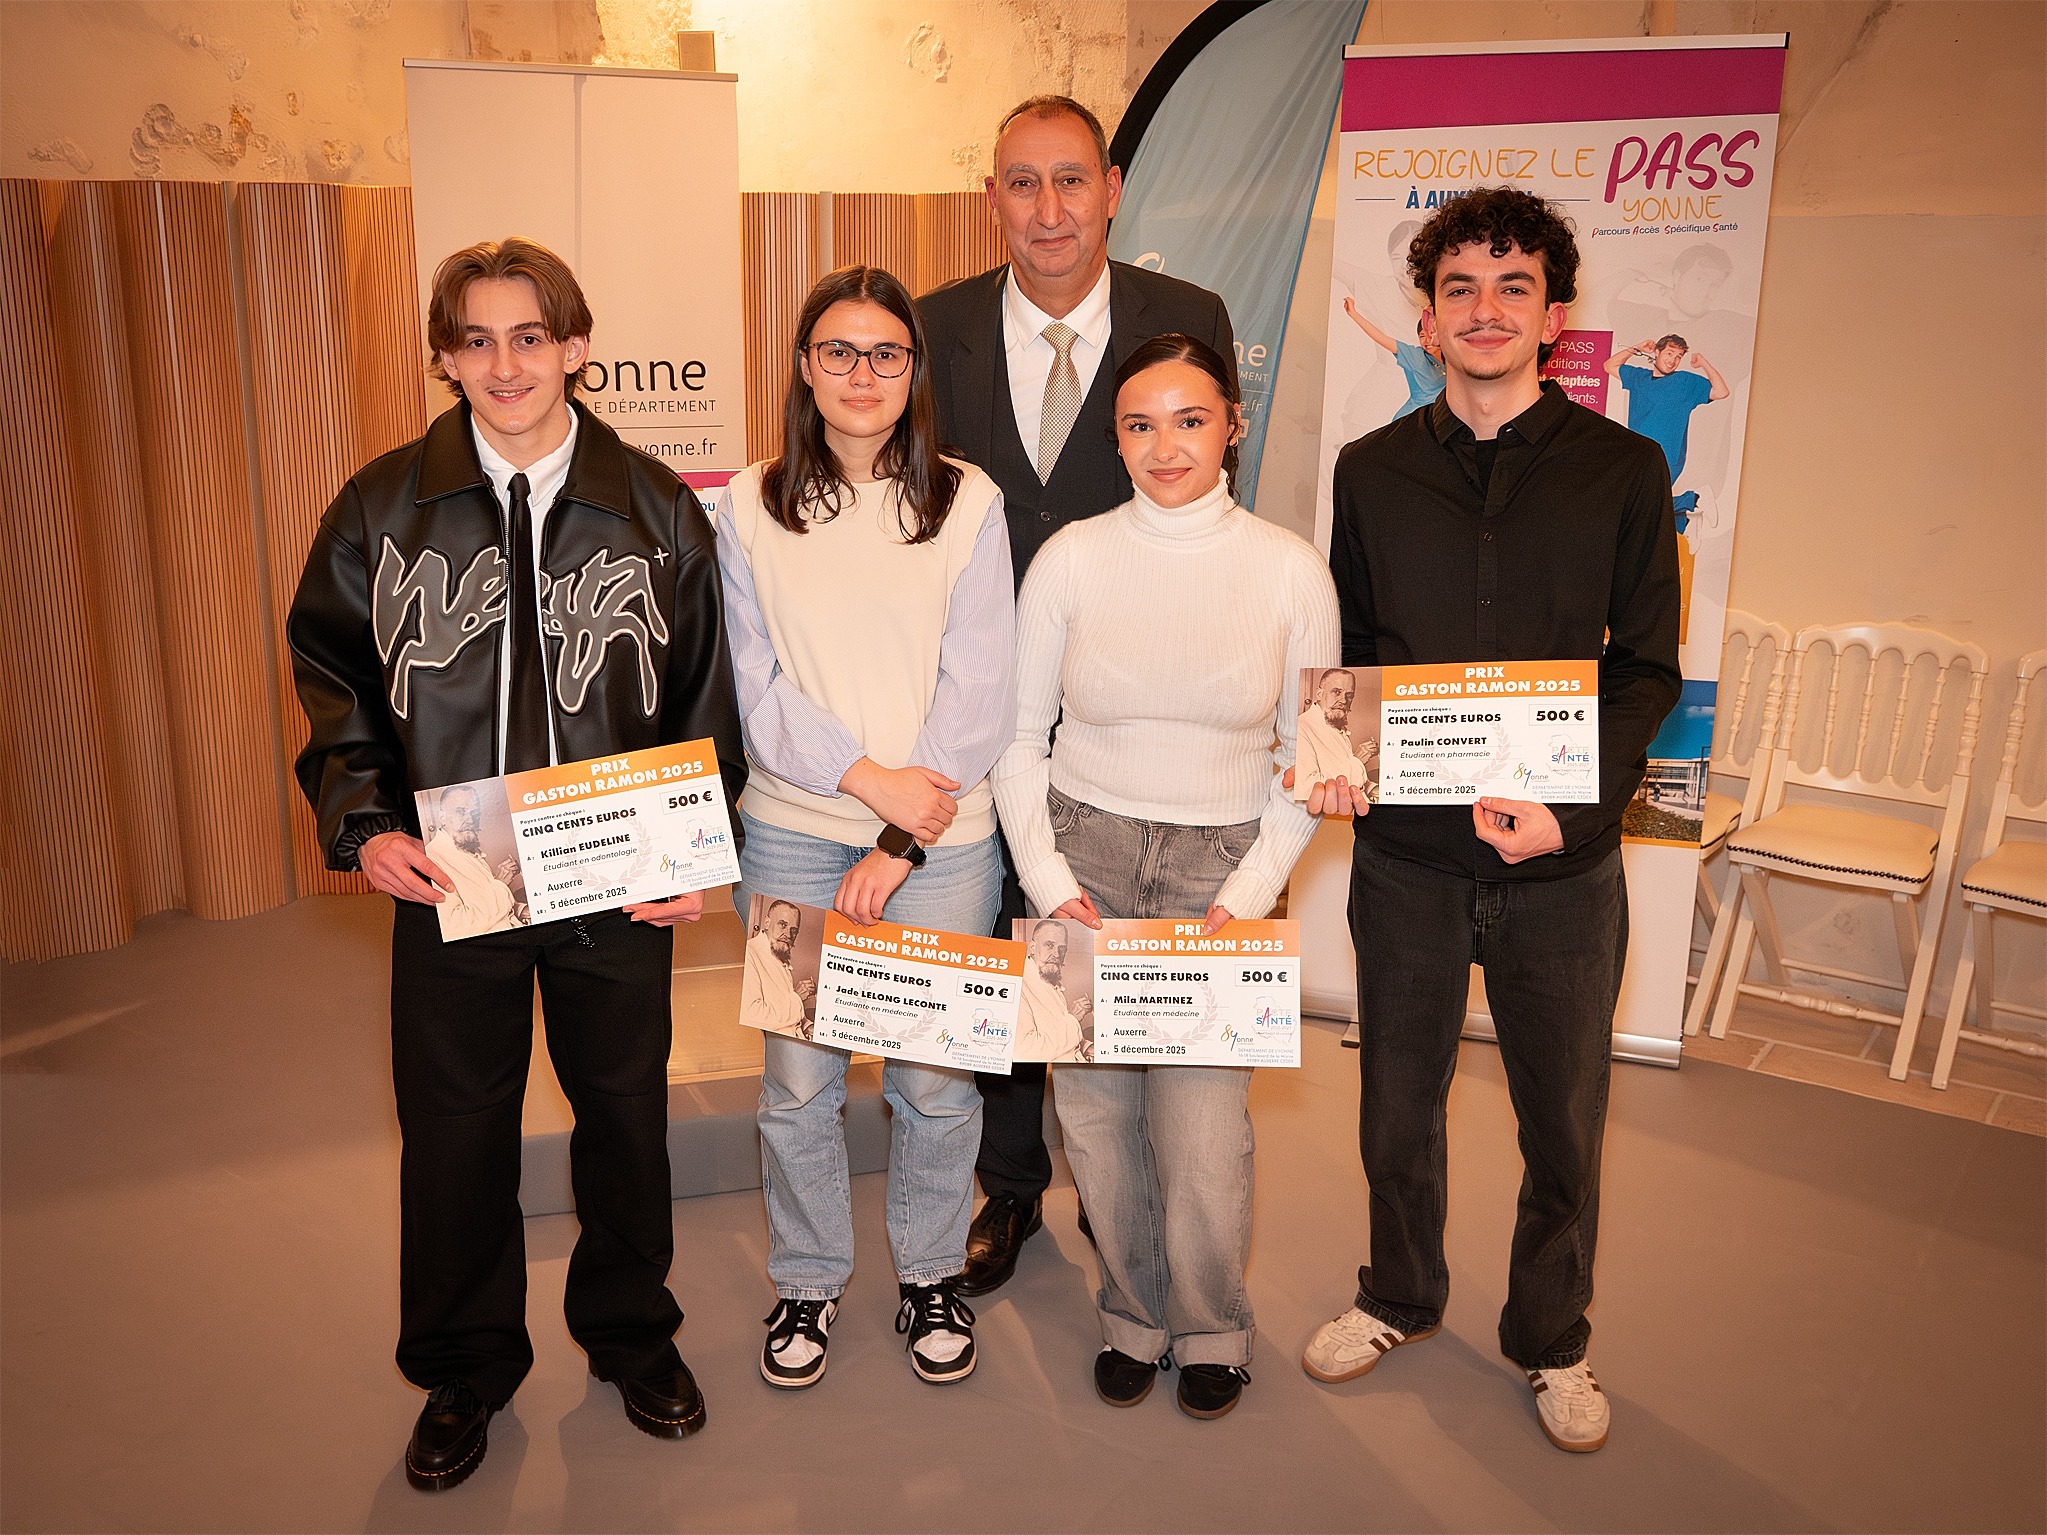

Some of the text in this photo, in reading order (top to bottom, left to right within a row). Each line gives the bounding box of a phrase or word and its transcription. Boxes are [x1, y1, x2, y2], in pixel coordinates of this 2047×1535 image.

[1354, 129, 1760, 203] REJOIGNEZ LE PASS
[1405, 185, 1420, 209] À
[1622, 195, 1722, 222] YONNE
[1591, 222, 1739, 238] Parcours Accès Spécifique Santé
[1560, 341, 1595, 354] PASS
[1548, 358, 1591, 370] ditions
[582, 360, 707, 392] onne
[1550, 374, 1600, 388] daptées
[608, 398, 717, 414] DÉPARTEMENT
[1465, 666, 1505, 679] PRIX
[1395, 679, 1581, 697] GASTON RAMON 2025
[1388, 713, 1502, 725] CINQ CENTS EUROS
[1536, 710, 1585, 722] 500 €
[1400, 738, 1434, 747] Paulin
[1436, 737, 1487, 746] CONVERT
[1400, 751, 1434, 759] Étudiant
[1446, 750, 1491, 759] pharmacie
[590, 757, 631, 777] PRIX
[1399, 770, 1435, 778] Auxerre
[522, 760, 704, 806] GASTON RAMON 2025
[1399, 786, 1405, 794] 5
[1407, 785, 1452, 795] décembre
[1454, 785, 1476, 794] 2025
[668, 790, 713, 809] 500 €
[522, 807, 637, 838] CINQ CENTS EUROS
[540, 846, 577, 859] Killian
[579, 833, 631, 851] EUDELINE
[543, 847, 638, 872] Étudiant en odontologie
[547, 878, 583, 892] Auxerre
[550, 900, 556, 910] 5
[558, 892, 604, 908] décembre
[605, 886, 627, 899] 2025
[1174, 924, 1205, 936] PRI
[901, 929, 940, 946] PRIX
[835, 932, 1009, 970] GASTON RAMON 2025
[1107, 939, 1284, 952] GASTON RAMON 2025
[826, 961, 932, 988] CINQ CENTS EUROS
[1100, 972, 1209, 982] CINQ CENTS EUROS
[1241, 971, 1287, 983] 500 €
[963, 982, 1009, 999] 500 €
[835, 985, 859, 997] Jade
[861, 990, 901, 1004] LELONG
[903, 997, 947, 1011] LECONTE
[1113, 995, 1137, 1004] Mila
[1139, 996, 1193, 1004] MARTINEZ
[881, 1007, 919, 1019] médecine
[1162, 1010, 1200, 1018] médecine
[833, 1014, 865, 1028] Auxerre
[1113, 1028, 1147, 1036] Auxerre
[832, 1029, 837, 1037] 5
[838, 1031, 880, 1046] décembre
[881, 1039, 902, 1050] 2025
[1113, 1045, 1119, 1053] 5
[1121, 1044, 1164, 1054] décembre
[1165, 1045, 1186, 1054] 2025
